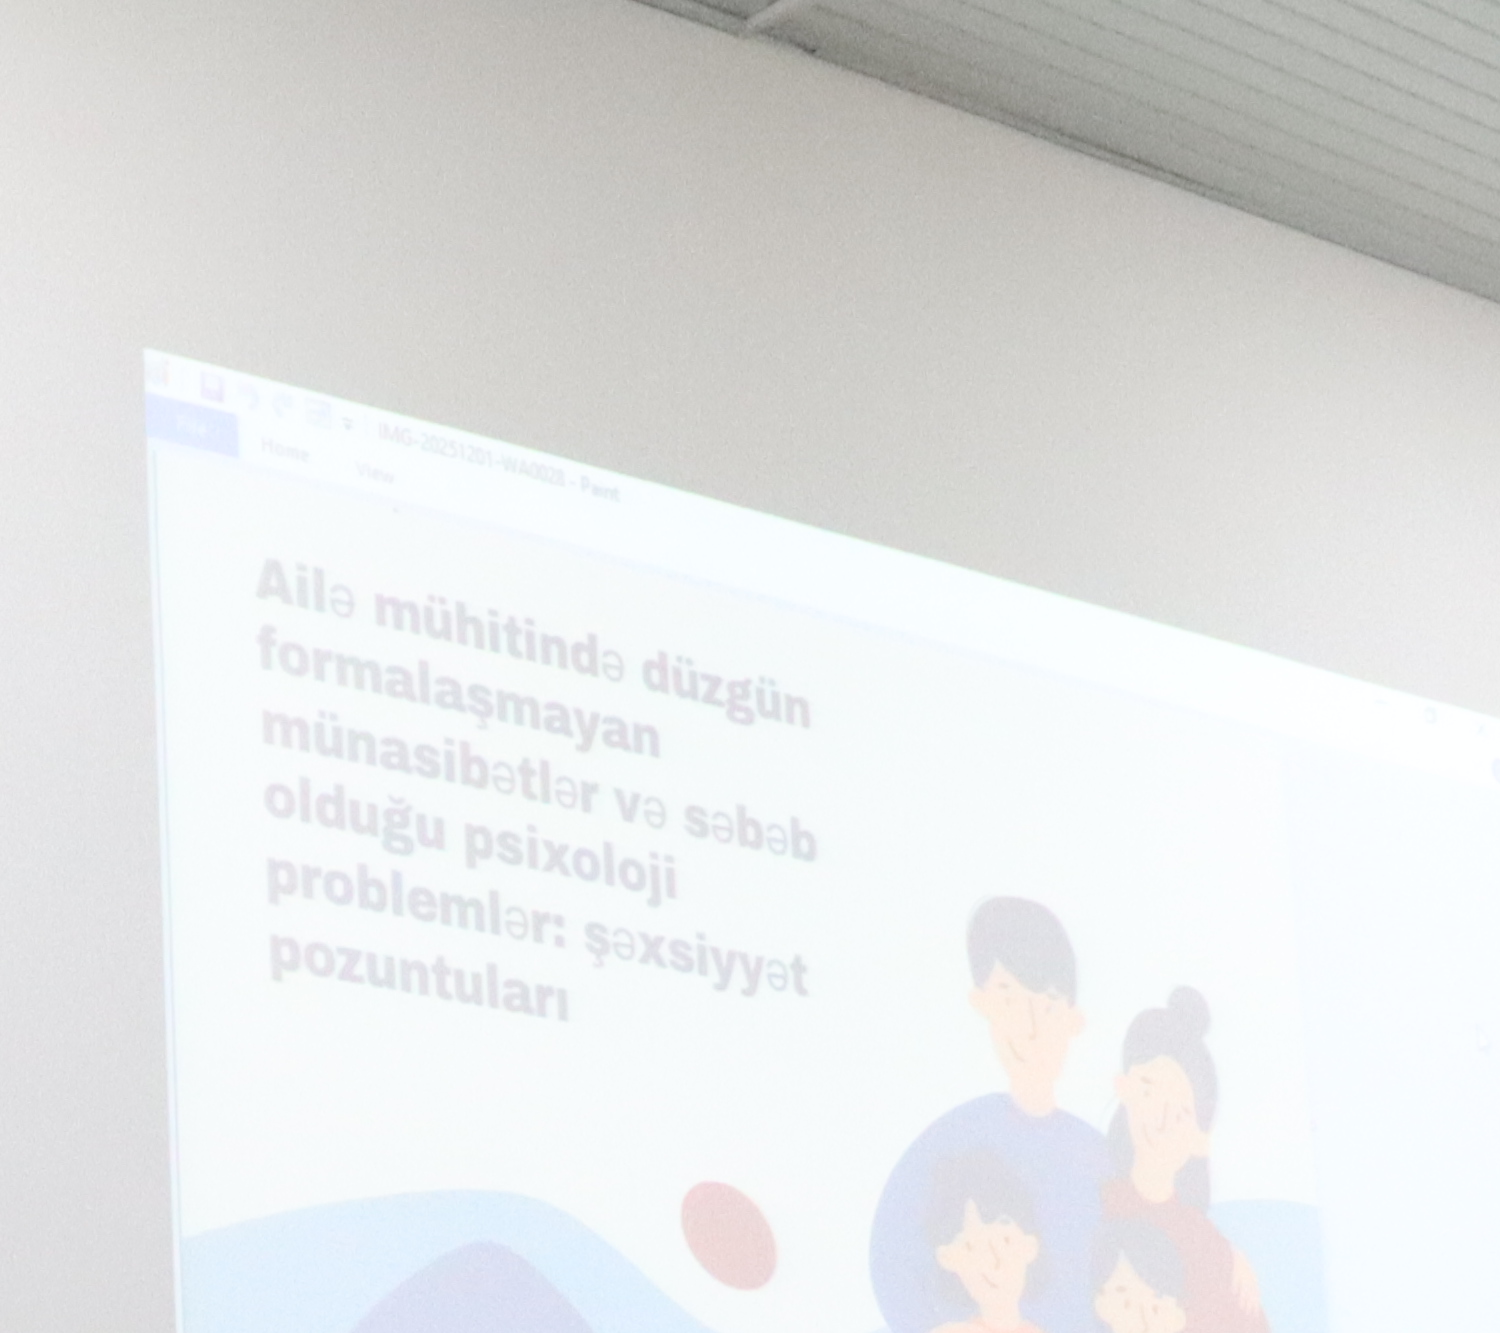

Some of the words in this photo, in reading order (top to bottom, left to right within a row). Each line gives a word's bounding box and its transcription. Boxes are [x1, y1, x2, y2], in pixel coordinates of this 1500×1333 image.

[260, 437, 310, 464] Home
[355, 460, 396, 485] View
[580, 474, 621, 503] Paint
[256, 558, 355, 619] Ailə
[374, 592, 625, 683] mühitində
[641, 650, 812, 729] düzgün
[256, 624, 662, 758] formalaşmayan
[262, 709, 600, 814] münasibətlər
[612, 785, 668, 830] və
[683, 803, 819, 863] səbəb
[263, 776, 446, 857] olduğu
[464, 822, 678, 909] psixoloji
[267, 857, 567, 949] problemlər:
[585, 918, 810, 999] şəxsiyyət
[269, 933, 570, 1022] pozuntuları
